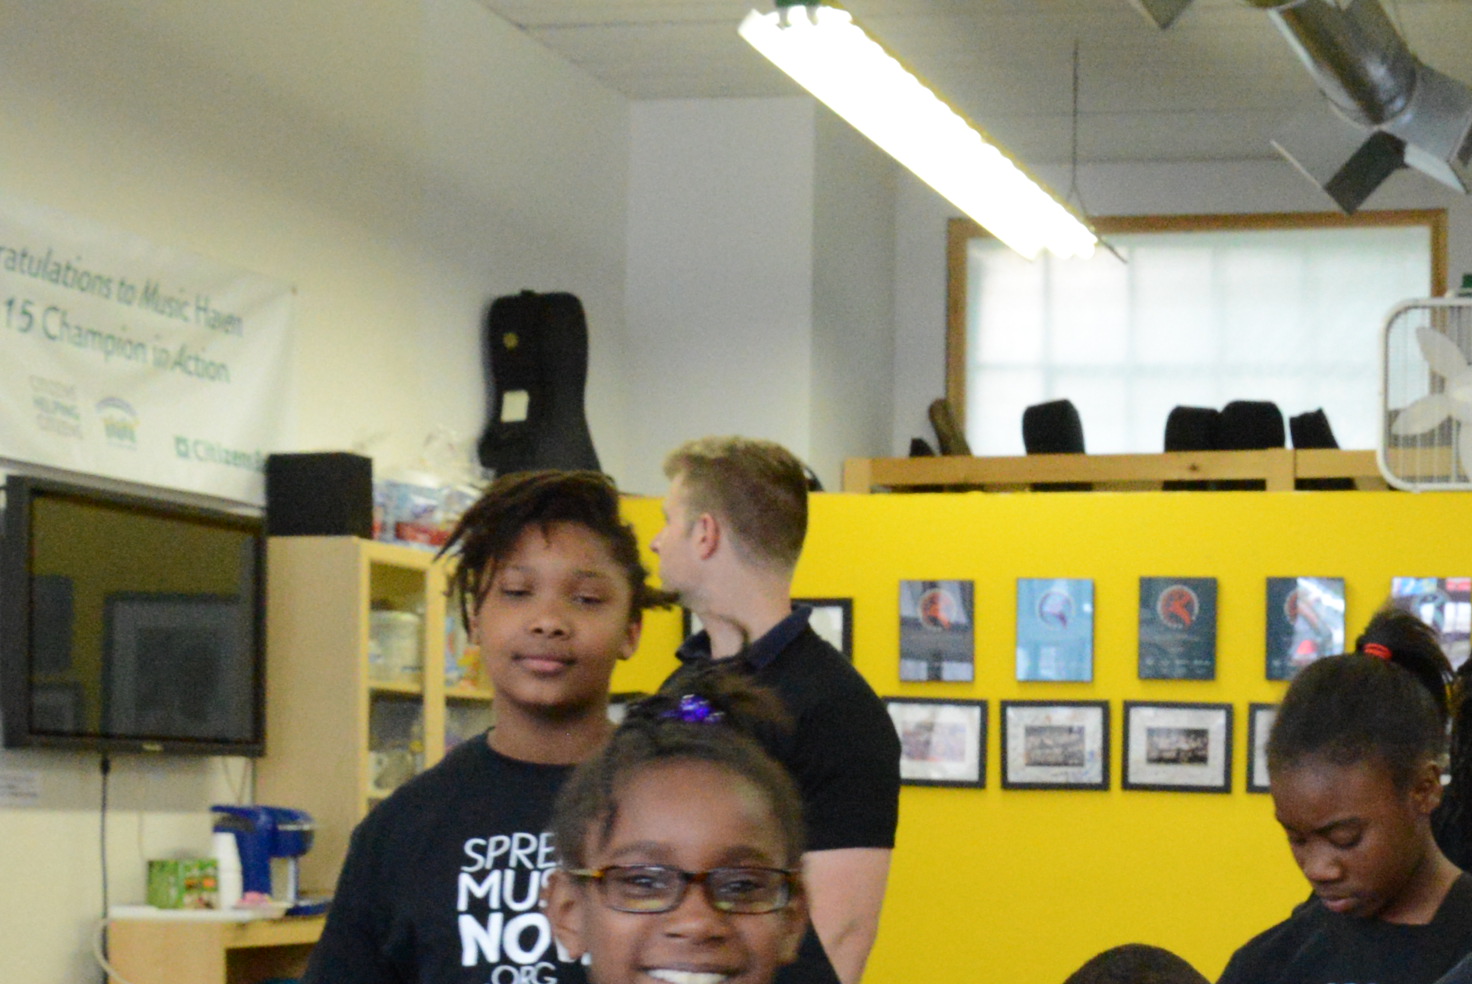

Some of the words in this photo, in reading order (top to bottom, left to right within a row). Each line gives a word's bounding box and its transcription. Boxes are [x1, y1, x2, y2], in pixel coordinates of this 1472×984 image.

[117, 278, 137, 305] to
[139, 278, 190, 323] Music
[194, 294, 243, 337] Haven
[41, 305, 148, 363] Champion
[170, 343, 231, 383] Action
[460, 832, 563, 873] SPRE
[457, 867, 558, 912] MU
[458, 912, 592, 967] NO
